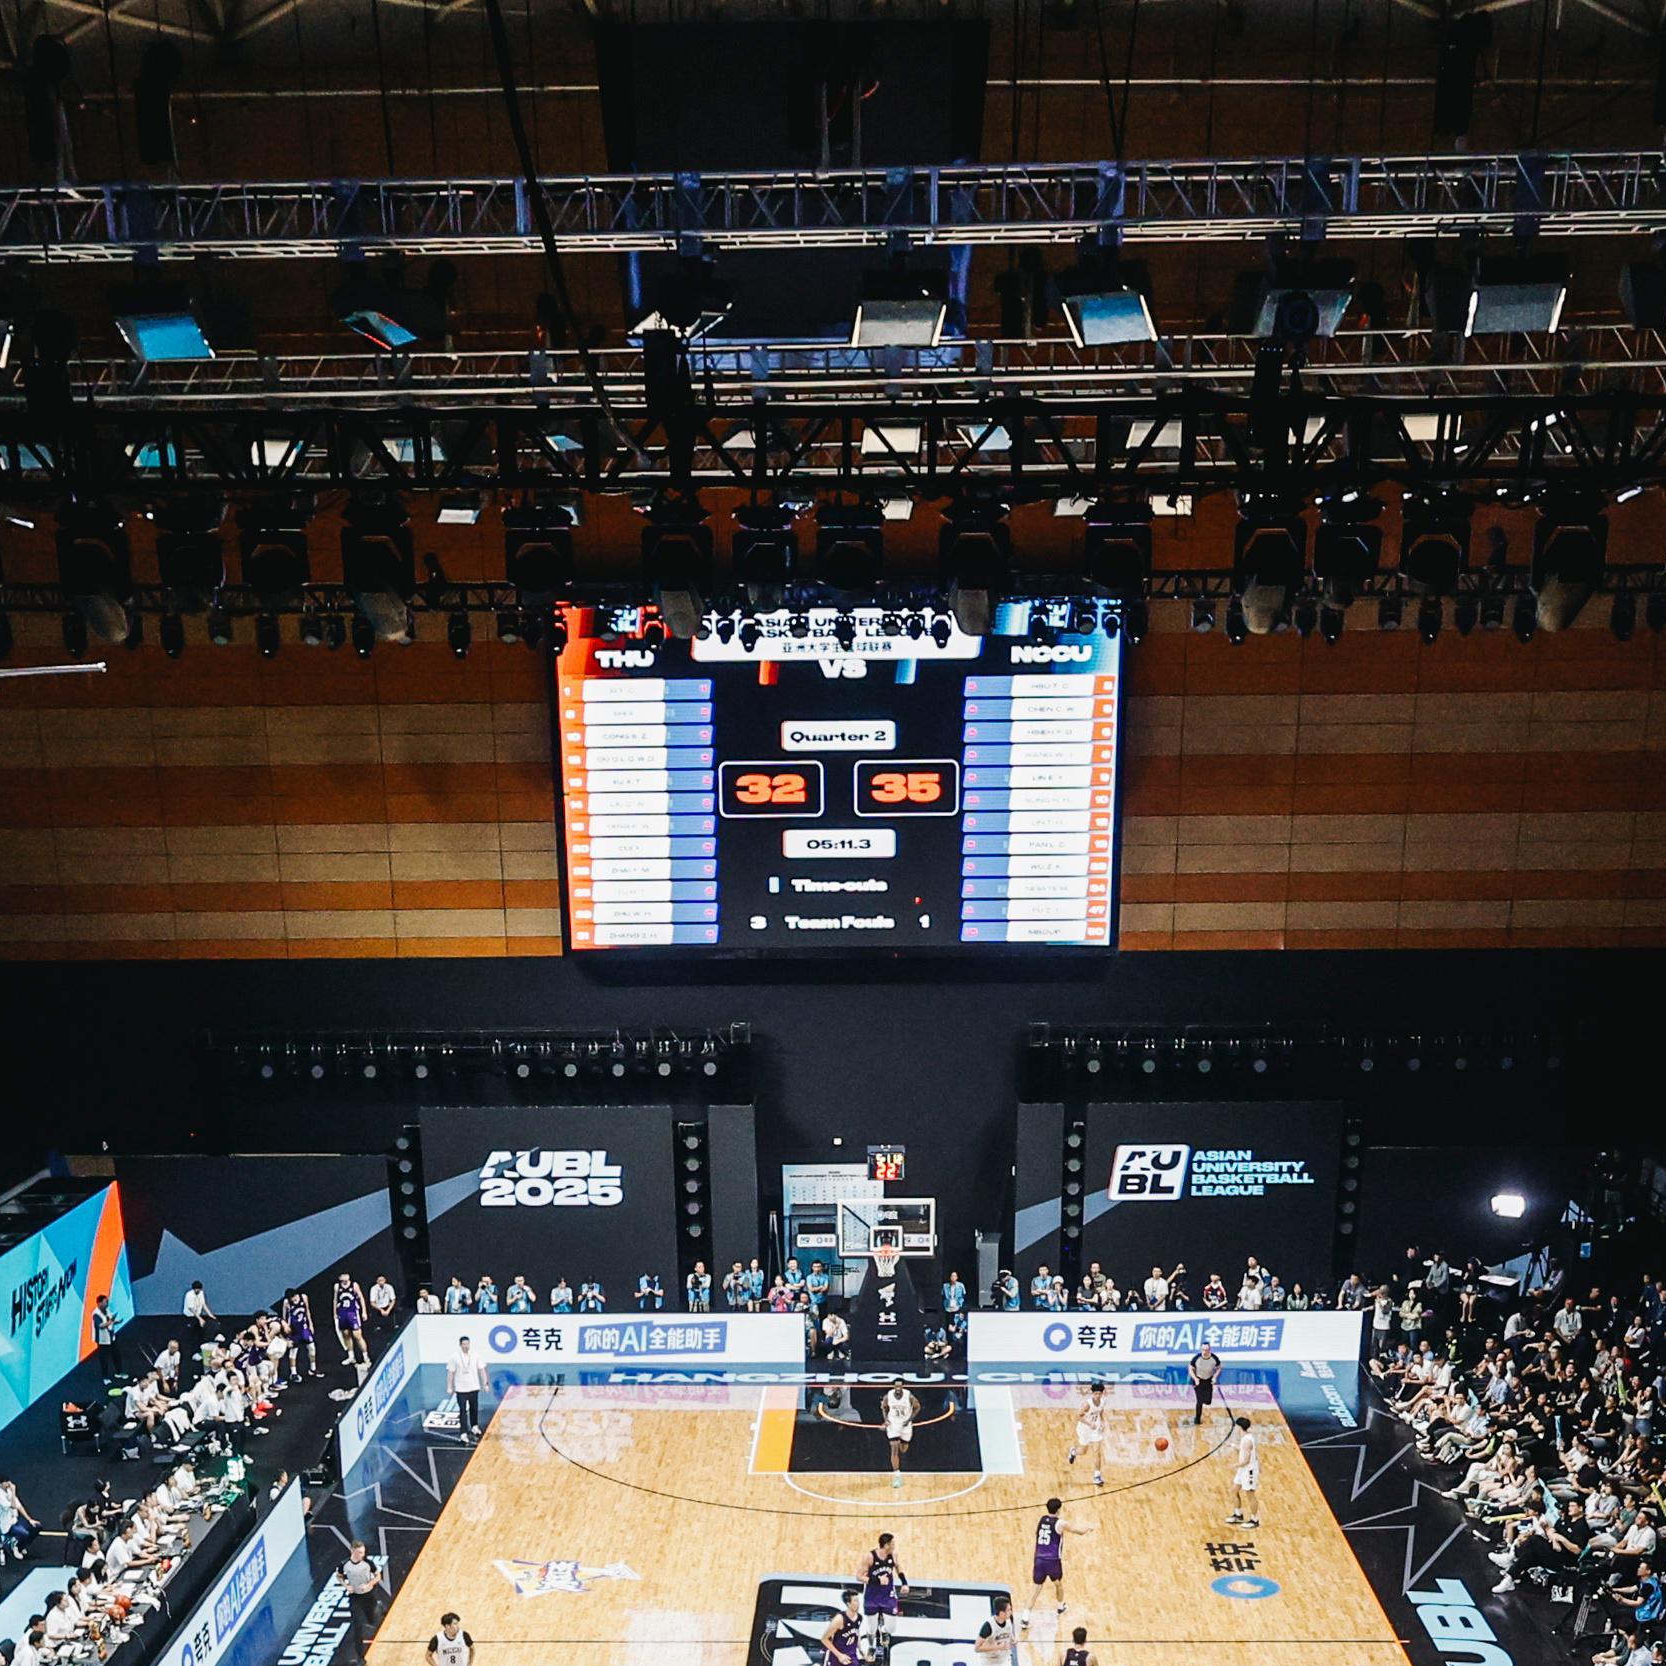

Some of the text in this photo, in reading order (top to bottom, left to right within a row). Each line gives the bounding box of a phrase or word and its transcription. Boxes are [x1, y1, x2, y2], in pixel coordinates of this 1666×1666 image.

[595, 650, 655, 668] THU
[819, 659, 868, 678] VS
[790, 731, 886, 743] Quarter 2
[735, 773, 806, 804] 32
[871, 772, 941, 803] 35
[807, 839, 871, 850] 05:11.3
[791, 878, 888, 892] Time-outs
[750, 914, 931, 929] 3 Team Fouls 1
[479, 1147, 622, 1178] AUBL
[1192, 1150, 1252, 1161] ASIAN
[1192, 1161, 1305, 1173] UNIVERSITY
[1118, 1174, 1175, 1194] BL
[1191, 1173, 1315, 1184] BASKETBALL
[480, 1178, 623, 1206] 2025
[1191, 1185, 1264, 1196] LEAGUE
[523, 1324, 721, 1353] 夸克 你的AI全能助手
[1077, 1322, 1277, 1352] 夸克 你的AI全能助手
[609, 1371, 1165, 1384] HANGZHOU CHINA
[450, 1655, 456, 1664] 8
